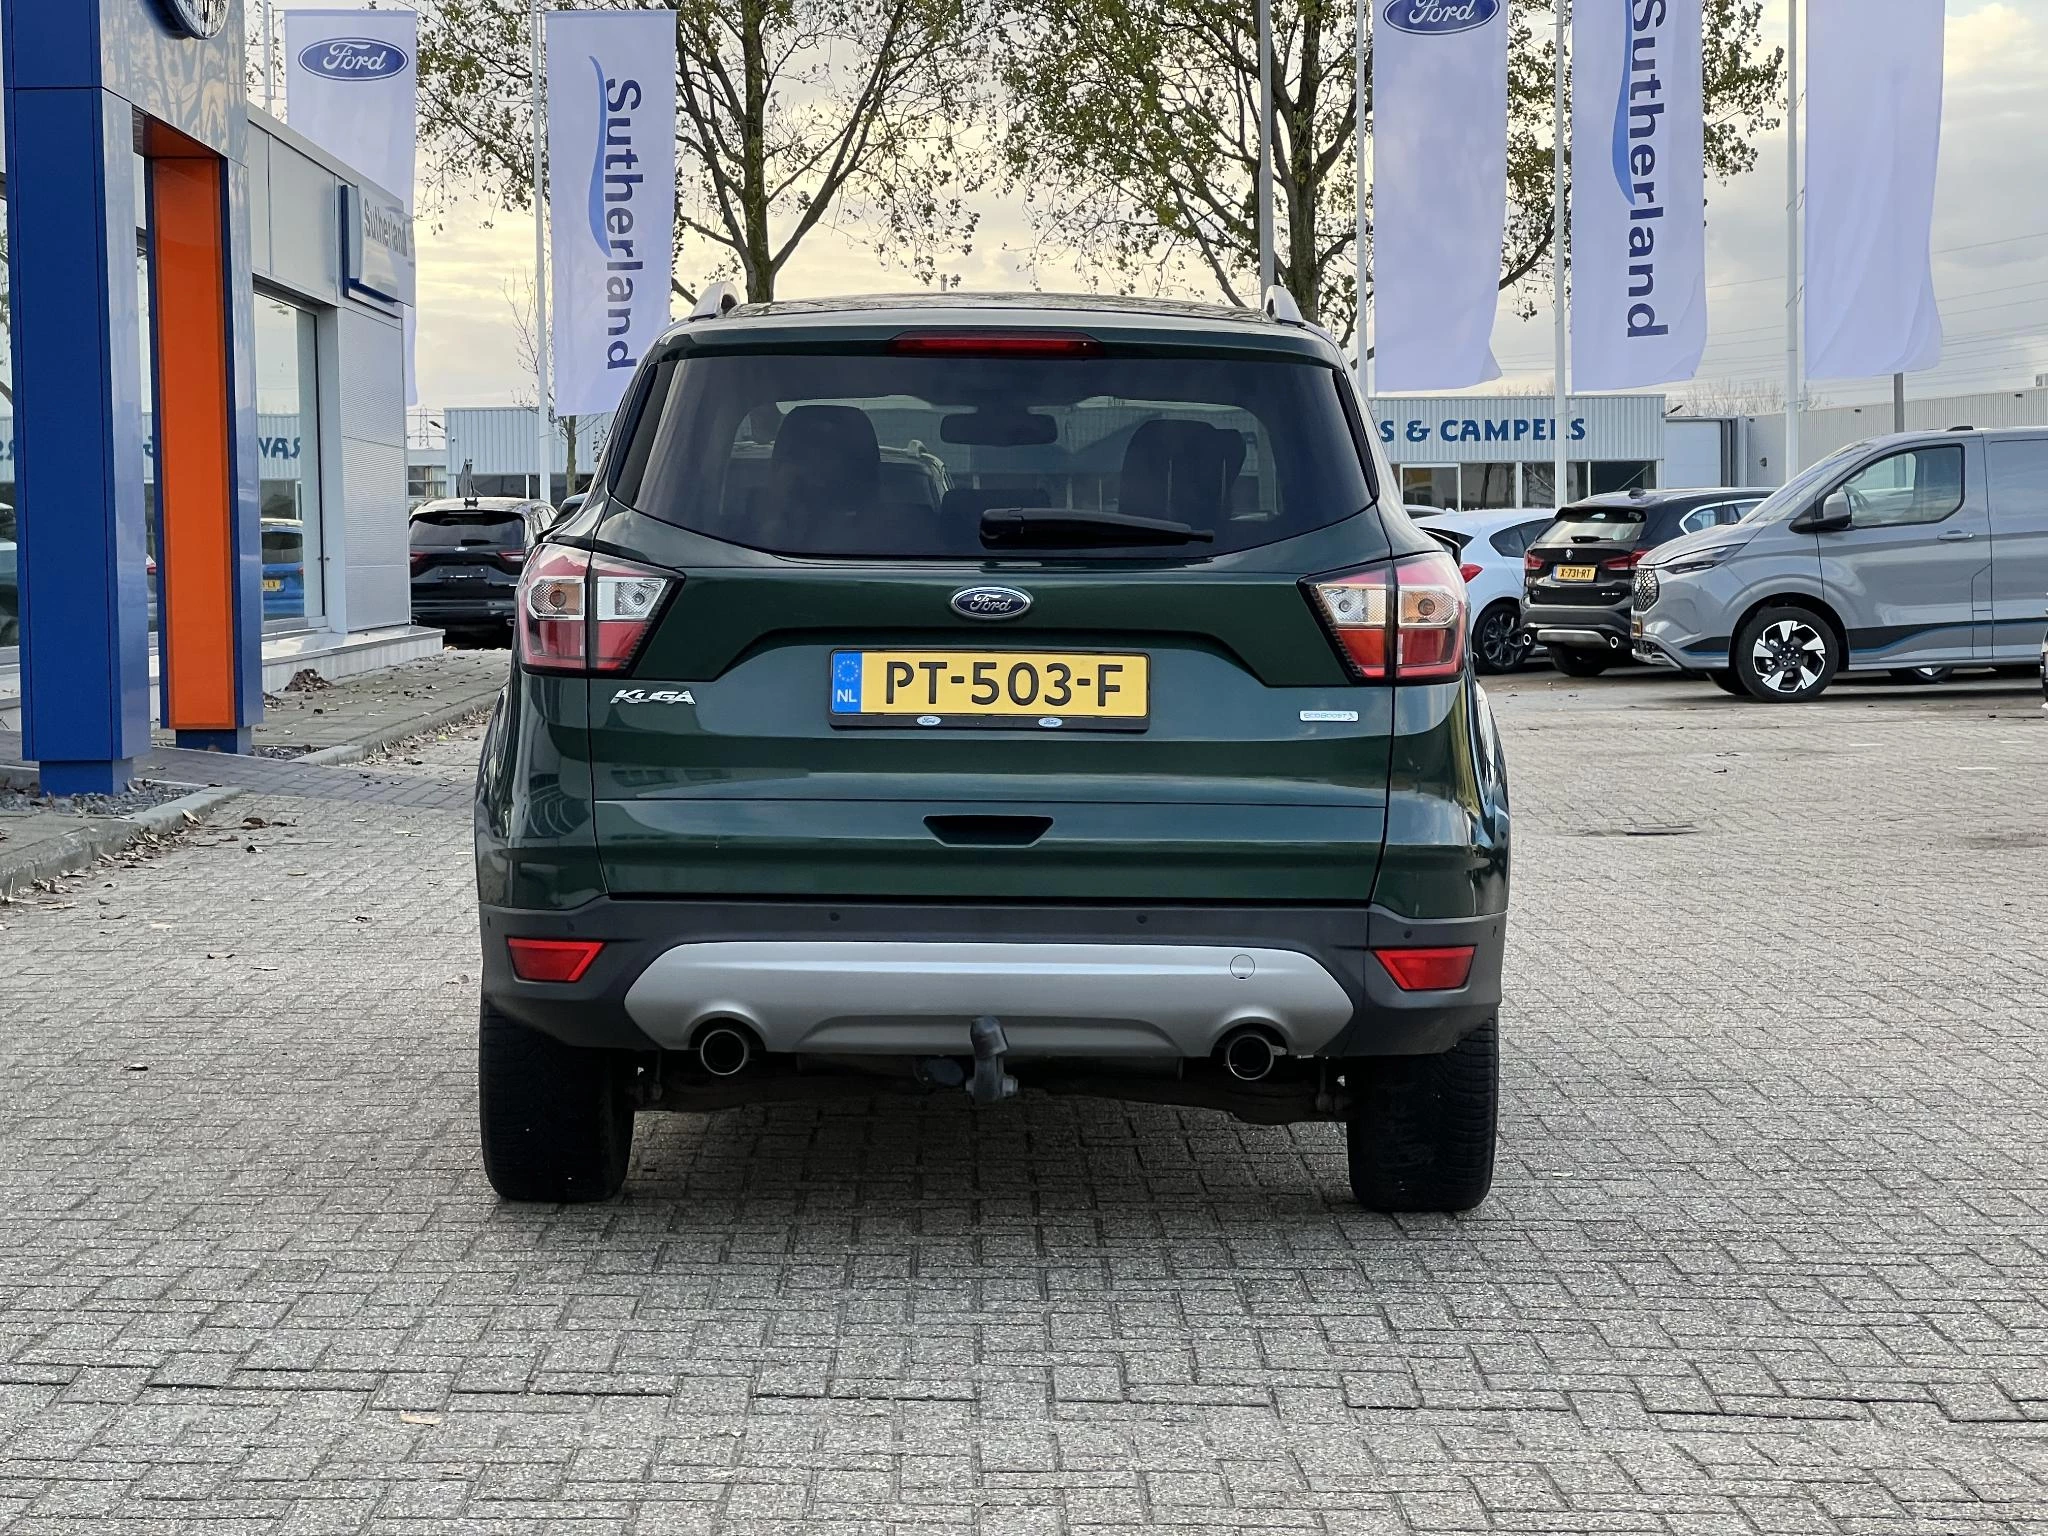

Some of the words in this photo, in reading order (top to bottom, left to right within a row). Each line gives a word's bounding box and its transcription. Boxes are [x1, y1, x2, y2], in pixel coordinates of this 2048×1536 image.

[1408, 0, 1475, 24] Ford
[322, 42, 386, 71] Ford
[1627, 0, 1669, 338] Sutherland
[364, 197, 408, 257] Sutherland
[604, 77, 644, 370] Sutherland
[1405, 420, 1431, 442] &
[969, 593, 1012, 611] Ford
[610, 689, 696, 705] KUGA
[837, 688, 857, 703] NL
[885, 661, 1124, 707] PT-503-F
